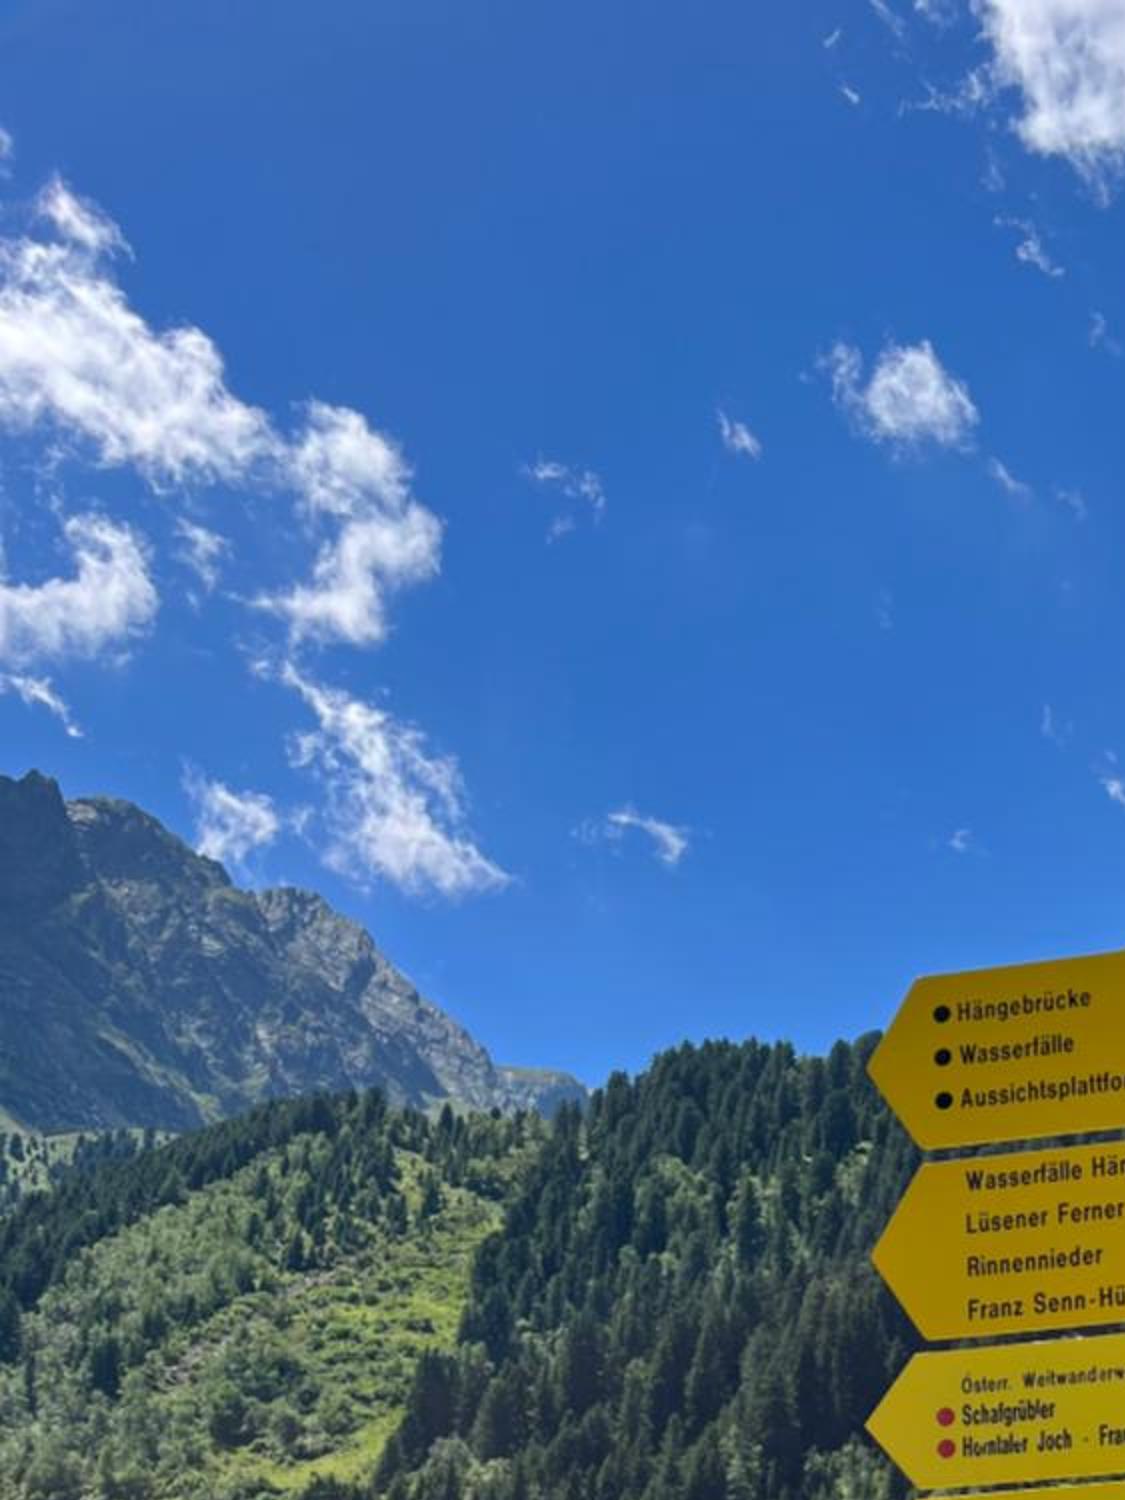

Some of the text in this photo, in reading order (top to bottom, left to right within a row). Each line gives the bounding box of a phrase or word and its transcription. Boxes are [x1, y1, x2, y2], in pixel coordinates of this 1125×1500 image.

[957, 989, 1091, 1022] Hängebrücke
[959, 1034, 1074, 1065] Wasserfälle
[965, 1161, 1084, 1191] Wasserfälle
[966, 1202, 1125, 1234] Lüsener Ferner
[967, 1247, 1103, 1277] Rinnennieder
[967, 1298, 1024, 1321] Franz
[961, 1398, 1056, 1428] Schafgrübler
[1036, 1428, 1073, 1453] Joch
